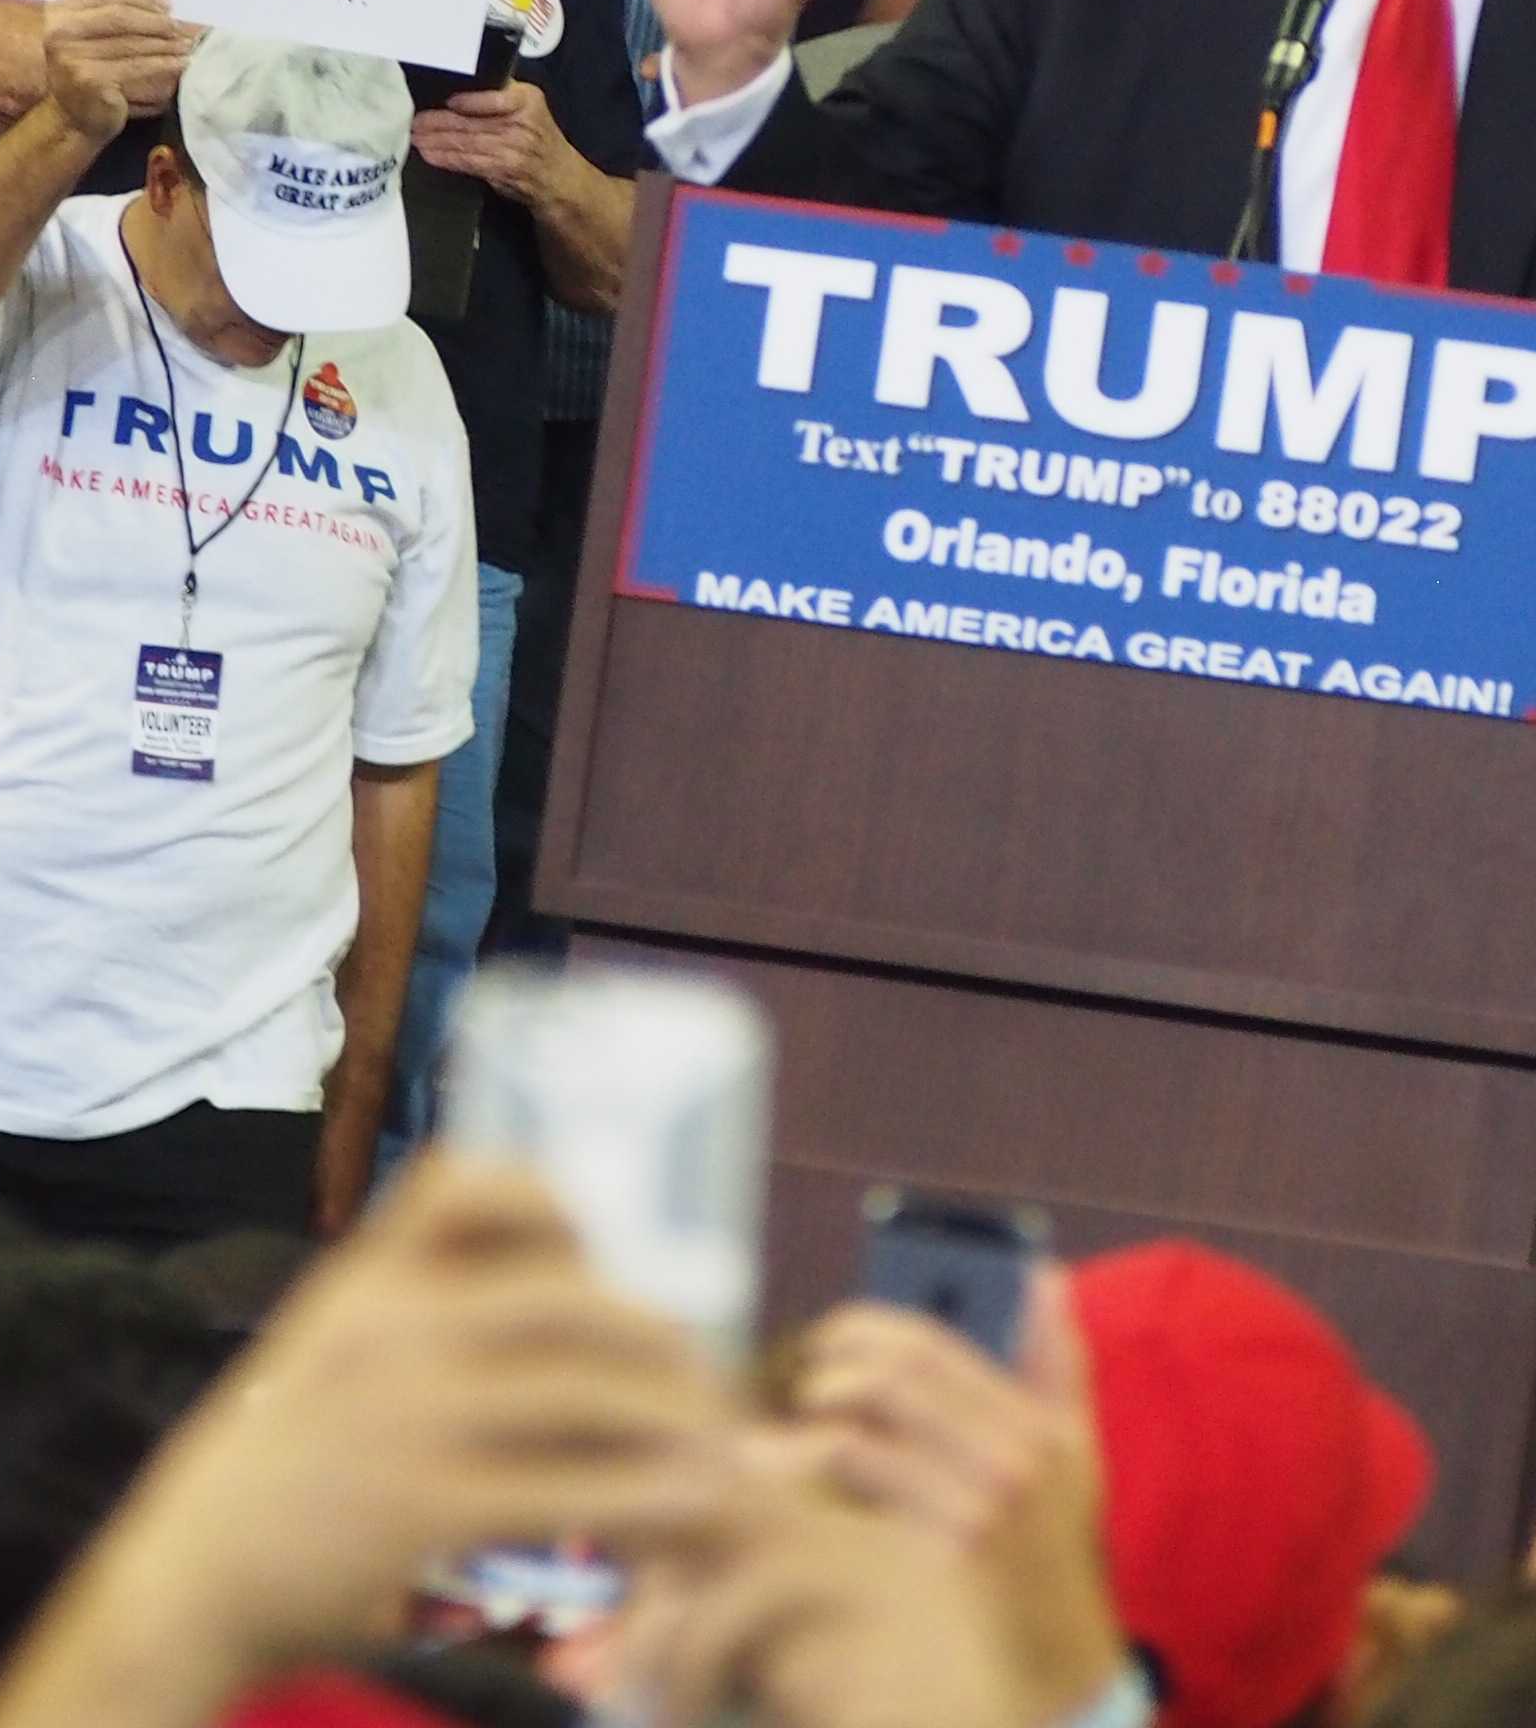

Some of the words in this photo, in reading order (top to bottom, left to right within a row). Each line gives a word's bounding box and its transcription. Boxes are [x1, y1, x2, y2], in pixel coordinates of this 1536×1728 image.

[268, 152, 326, 185] MAKE
[275, 183, 340, 210] GREAT
[61, 389, 397, 504] TRUMP
[794, 419, 904, 477] Text
[1191, 478, 1243, 523] to
[1258, 481, 1462, 551] 88022
[40, 453, 102, 493] MAKE
[112, 477, 232, 520] AMERICA
[241, 499, 326, 532] GREAT
[884, 509, 1144, 604] Orlando,
[1161, 545, 1378, 626] Florida
[144, 660, 215, 683] TRUMP
[695, 572, 854, 626] MAKE
[866, 596, 1112, 662] AMERICA
[1126, 629, 1314, 689] GREAT
[1321, 658, 1514, 716] AGAIN!
[140, 709, 212, 737] VOLUNTEER
